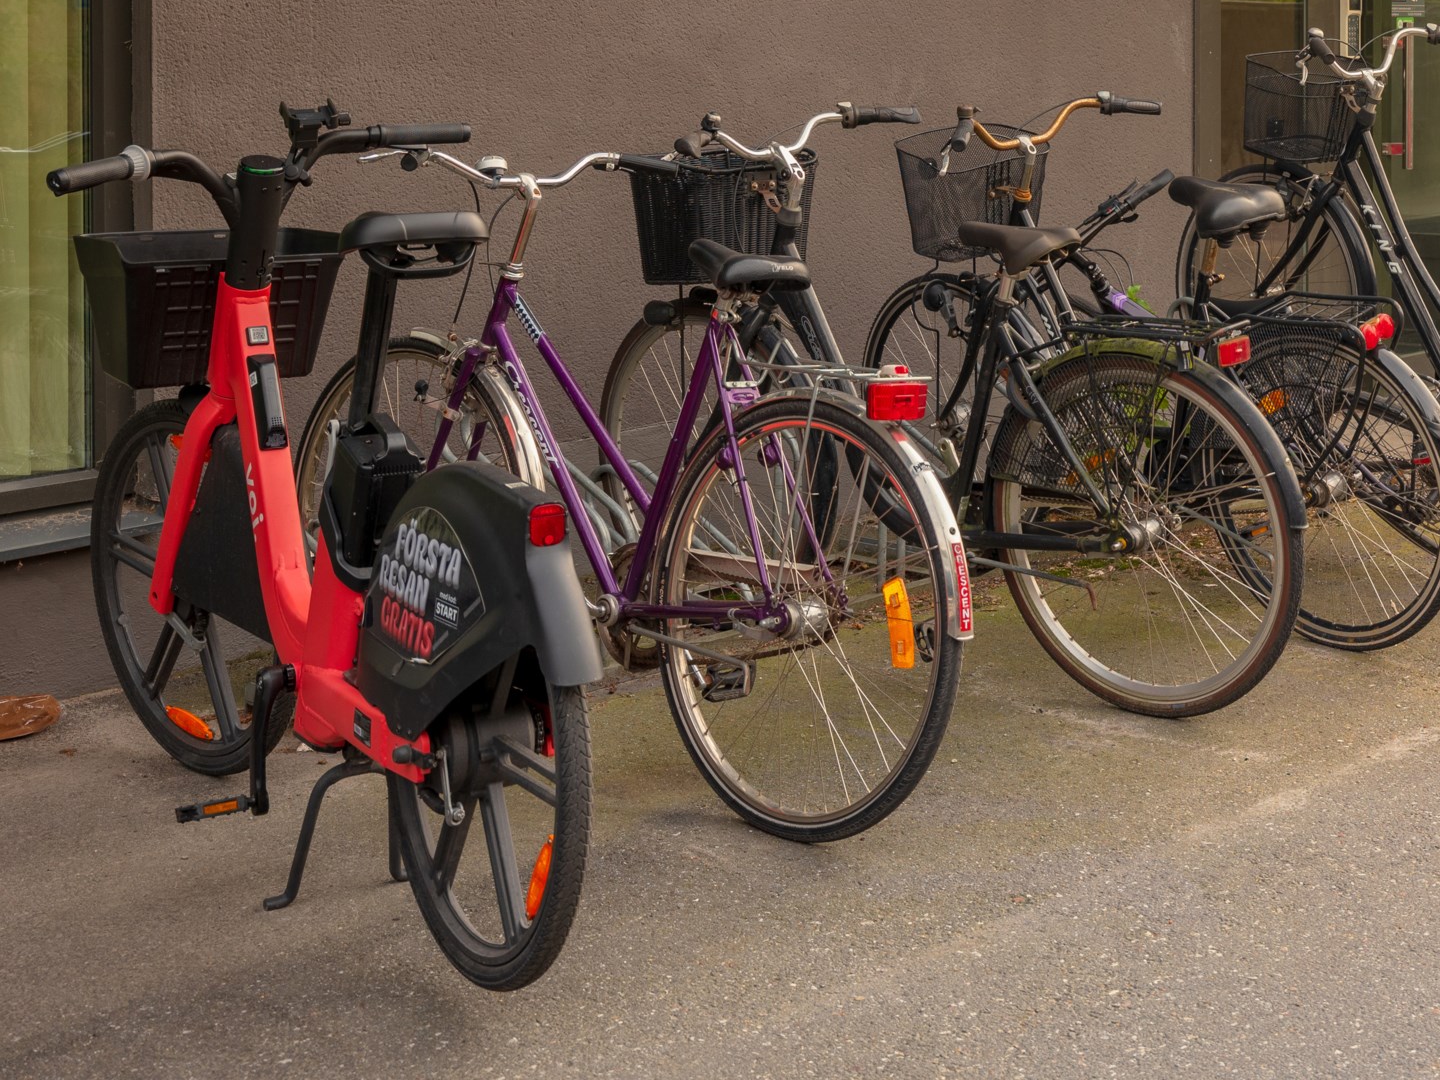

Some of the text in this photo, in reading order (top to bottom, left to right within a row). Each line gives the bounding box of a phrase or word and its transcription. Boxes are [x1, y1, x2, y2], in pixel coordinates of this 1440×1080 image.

[1360, 204, 1402, 276] KING
[505, 360, 560, 469] Crescent
[379, 554, 430, 616] RESAN
[395, 518, 461, 590] FÖRSTA
[954, 544, 969, 629] CRESCENT
[380, 596, 435, 658] GRATIS
[436, 602, 458, 622] START
